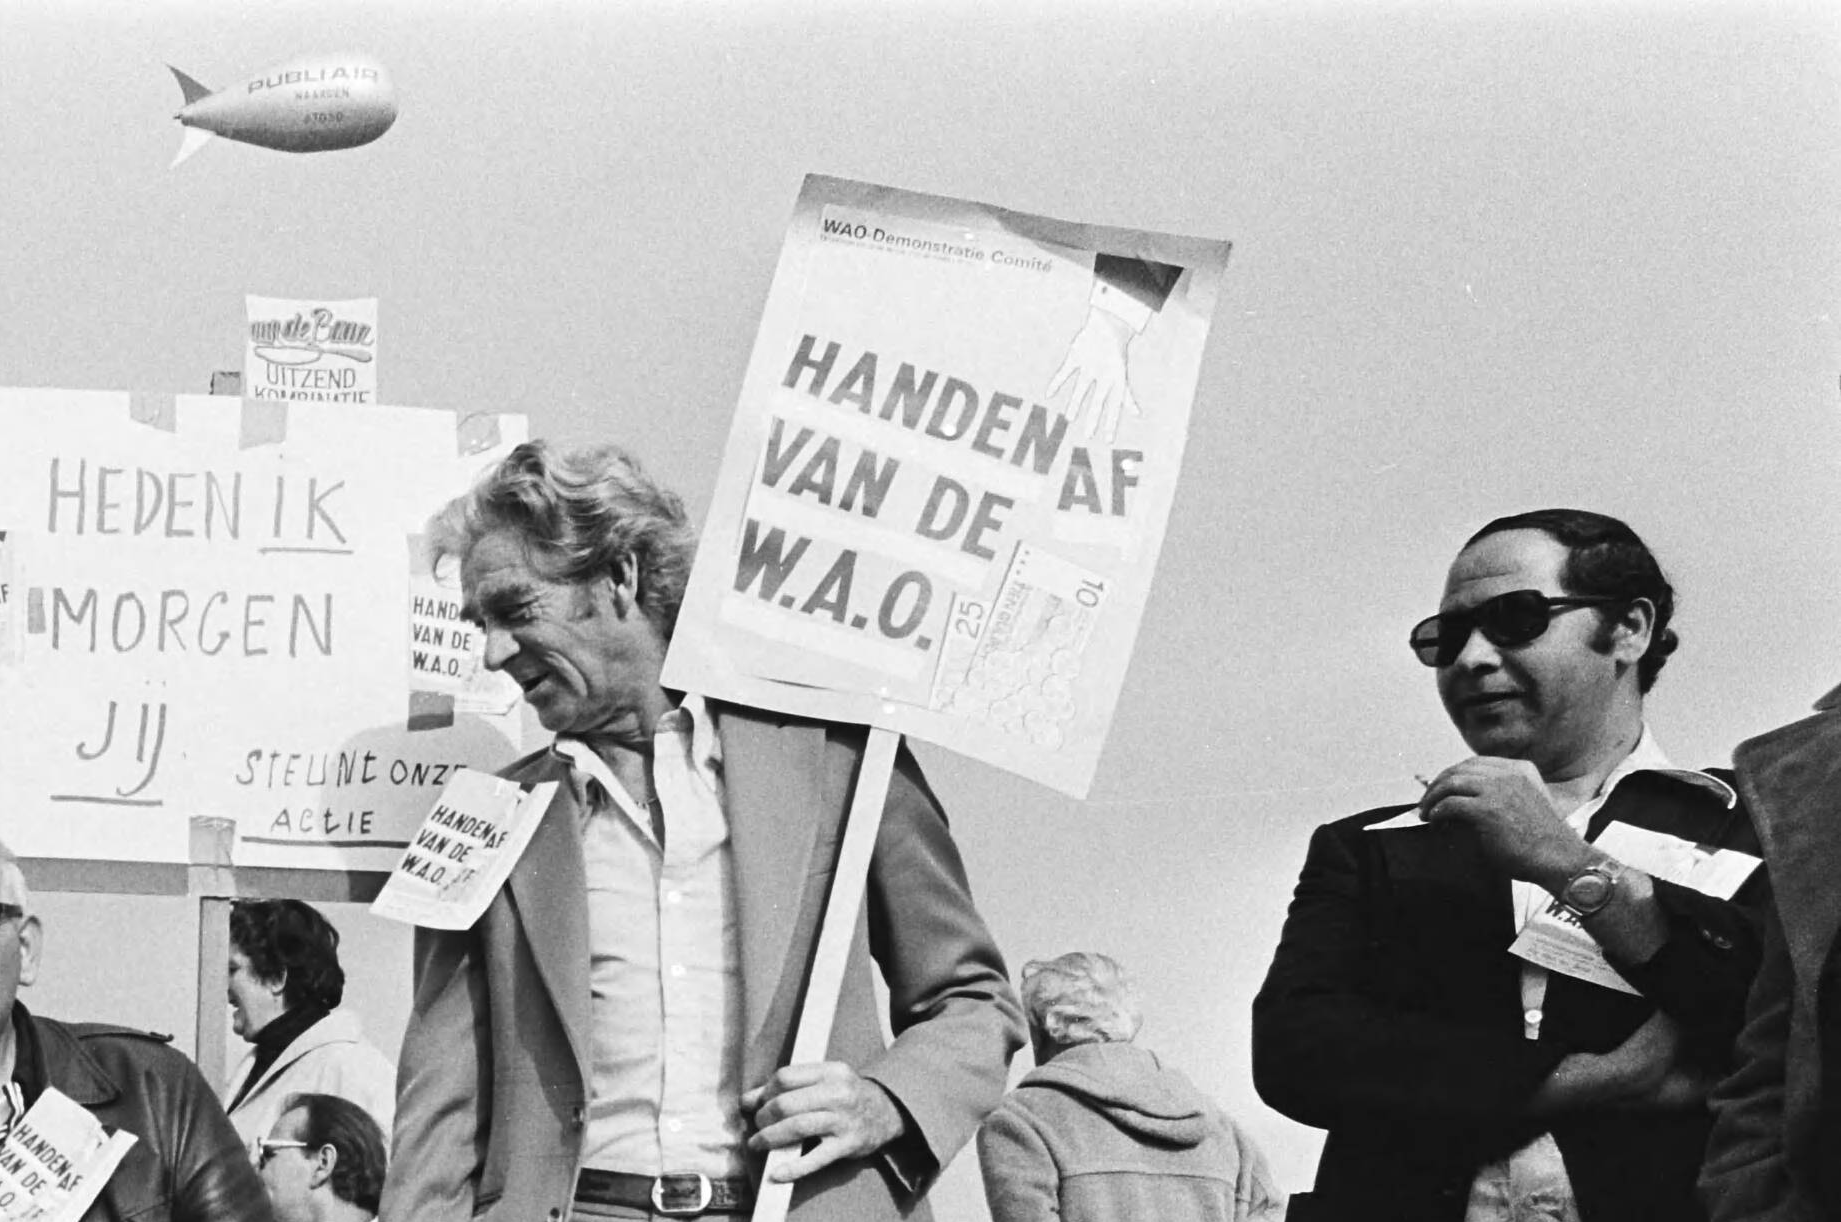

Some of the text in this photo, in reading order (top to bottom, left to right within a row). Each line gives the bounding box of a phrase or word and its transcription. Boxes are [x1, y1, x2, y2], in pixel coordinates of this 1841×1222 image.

[266, 363, 356, 389] UITZEND
[781, 334, 1143, 517] HANDEN AF
[48, 456, 243, 540] HEDEN
[759, 416, 1014, 562] VAN DE
[732, 517, 935, 650] W.A.O.
[1076, 579, 1104, 608] 10
[51, 586, 333, 658] MORGEN
[413, 595, 459, 620] HAND
[955, 601, 984, 640] 25
[413, 623, 472, 652] VAN DE
[413, 650, 461, 678] W.A.O.
[390, 760, 468, 787] ONZ
[430, 805, 508, 850] HANDEN AF
[415, 829, 474, 863] VAN DE
[401, 853, 446, 886] W.A.O.
[13, 1123, 83, 1192] HANDEN AF
[20, 1171, 47, 1196] DE
